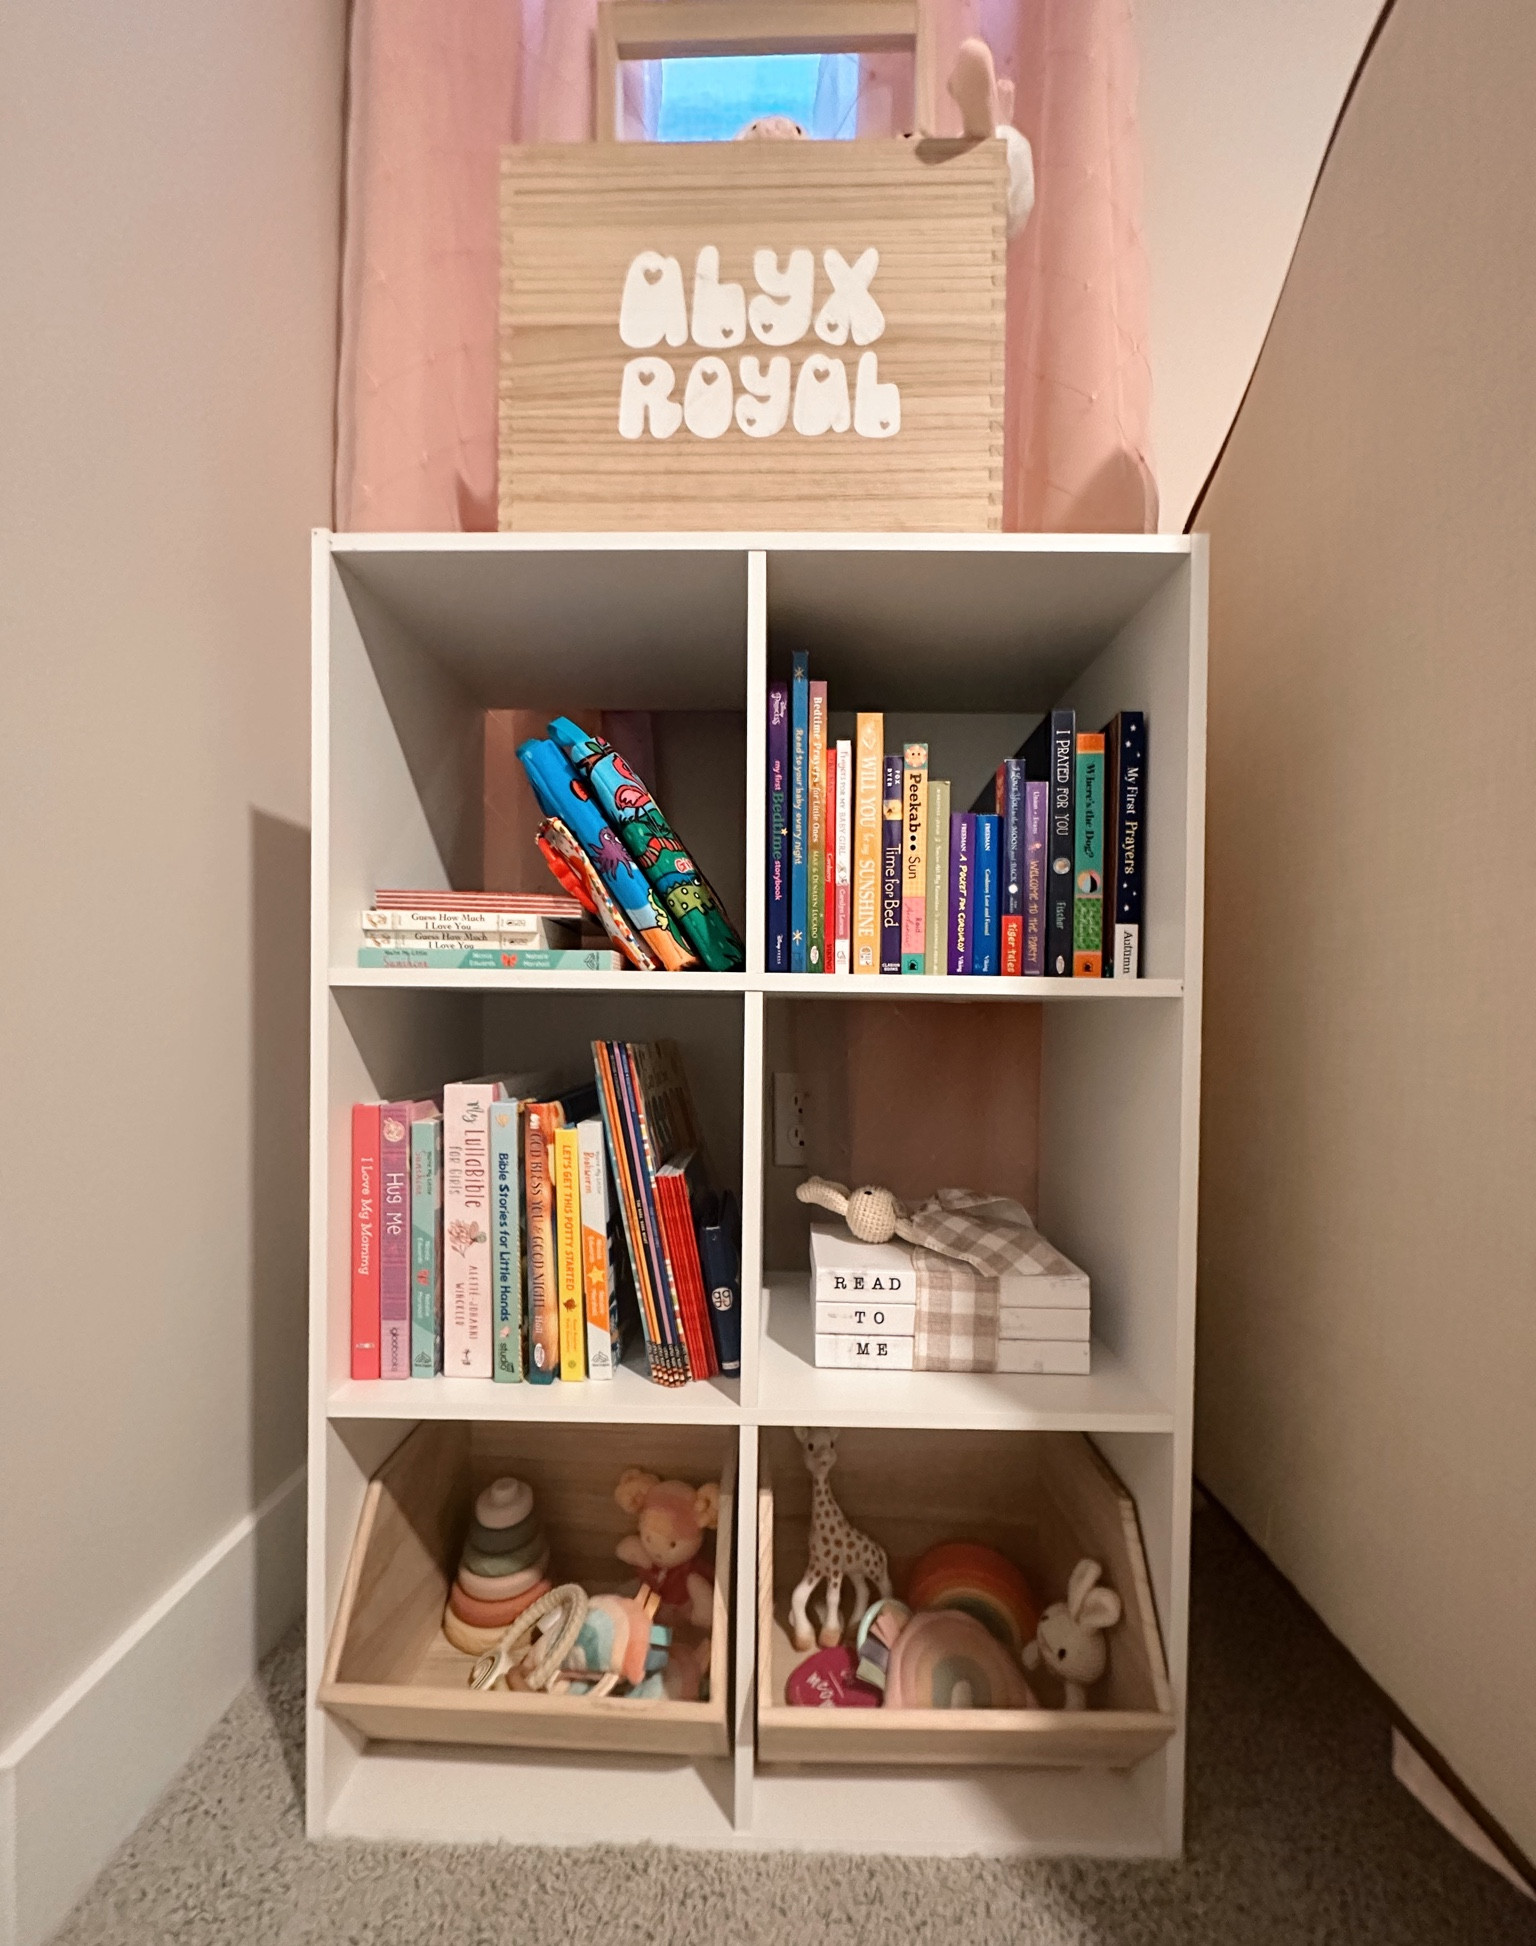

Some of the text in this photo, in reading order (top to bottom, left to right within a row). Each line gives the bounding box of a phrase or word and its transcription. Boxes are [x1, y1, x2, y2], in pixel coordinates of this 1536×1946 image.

[618, 350, 901, 439] ROYAL
[771, 692, 782, 726] Princess
[813, 697, 823, 739] Bedtime
[773, 760, 783, 790] my first
[812, 742, 822, 783] Prayers
[861, 756, 877, 793] WILL
[1056, 740, 1070, 783] PRAYED
[793, 728, 804, 865] Read to your baby every night
[813, 787, 821, 799] for
[840, 798, 847, 810] MY
[1057, 788, 1070, 809] FOR
[773, 791, 785, 860] Bedtime
[813, 800, 821, 821] Little
[840, 812, 848, 834] BABY
[860, 797, 877, 828] YOU
[1055, 814, 1070, 836] YOU
[1084, 763, 1096, 859] Where's the Dog?
[1122, 767, 1138, 874] My First Prayers
[839, 836, 847, 857] GIRL
[960, 853, 967, 862] A
[773, 860, 782, 901] storybook
[908, 856, 921, 880] Sun
[959, 864, 968, 896] POCKET
[1029, 861, 1039, 901] WELCOME
[858, 860, 875, 937] SUNSHINE
[884, 843, 901, 928] Time for Bed
[411, 912, 485, 922] Guess How Much
[432, 922, 451, 930] Love
[455, 922, 472, 930] You
[812, 909, 820, 939] LUCADO
[1056, 902, 1067, 931] Fischer
[414, 931, 488, 941] Guess How Much
[435, 941, 455, 949] Love
[459, 941, 474, 949] You
[957, 912, 966, 952] CORDUROY
[1008, 923, 1018, 948] tiger
[1007, 950, 1016, 973] tales
[1028, 936, 1037, 963] PARTY
[1123, 931, 1133, 974] Autumn
[462, 1101, 485, 1208] My LullaBible
[530, 1133, 541, 1158] GOD
[361, 1165, 373, 1195] Love
[531, 1162, 543, 1195] BLESS
[583, 1151, 595, 1195] Bookworm
[358, 1198, 372, 1220] My
[386, 1173, 404, 1235] Hug Me
[532, 1200, 545, 1222] YOU
[562, 1145, 575, 1291] LET'S GET THIS POTTY STARTED
[358, 1223, 373, 1276] Mommy
[499, 1153, 511, 1322] Bible Stories for Little Hands
[532, 1236, 545, 1269] GOOD
[532, 1273, 546, 1309] NIGHT
[833, 1275, 902, 1291] READ
[535, 1315, 543, 1334] Hall
[854, 1311, 886, 1325] TO
[856, 1342, 888, 1357] ME
